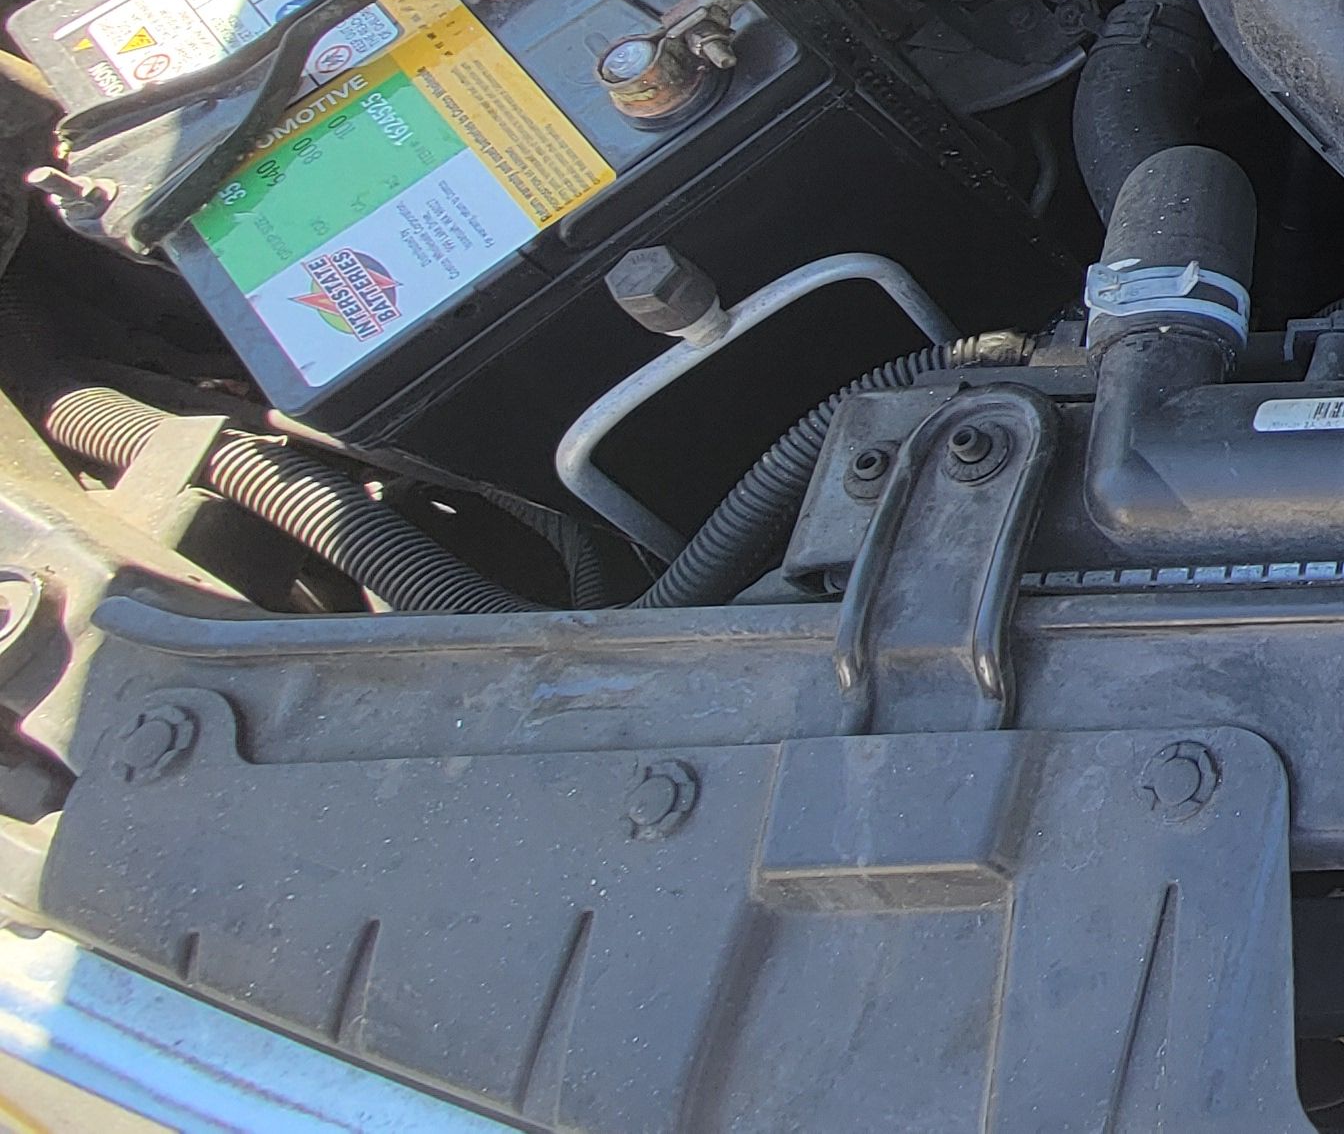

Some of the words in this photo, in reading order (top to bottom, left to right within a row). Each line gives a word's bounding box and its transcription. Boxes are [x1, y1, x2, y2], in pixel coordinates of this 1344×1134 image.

[414, 64, 447, 98] Wholesale
[251, 72, 369, 153] OMOTIVE
[360, 89, 416, 147] 1624525
[439, 93, 463, 118] Costco
[325, 112, 357, 141] 100
[461, 119, 492, 150] batteries
[291, 135, 324, 166] 800
[483, 145, 504, 164] used
[254, 157, 287, 188] 640
[495, 160, 513, 175] and
[216, 179, 248, 206] 35
[505, 168, 534, 200] warranty
[525, 196, 552, 222] Return
[264, 231, 293, 261] GROUP
[403, 234, 432, 267] Distributed
[306, 255, 378, 339] INTERSTATE
[329, 246, 397, 324] BATTERIES
